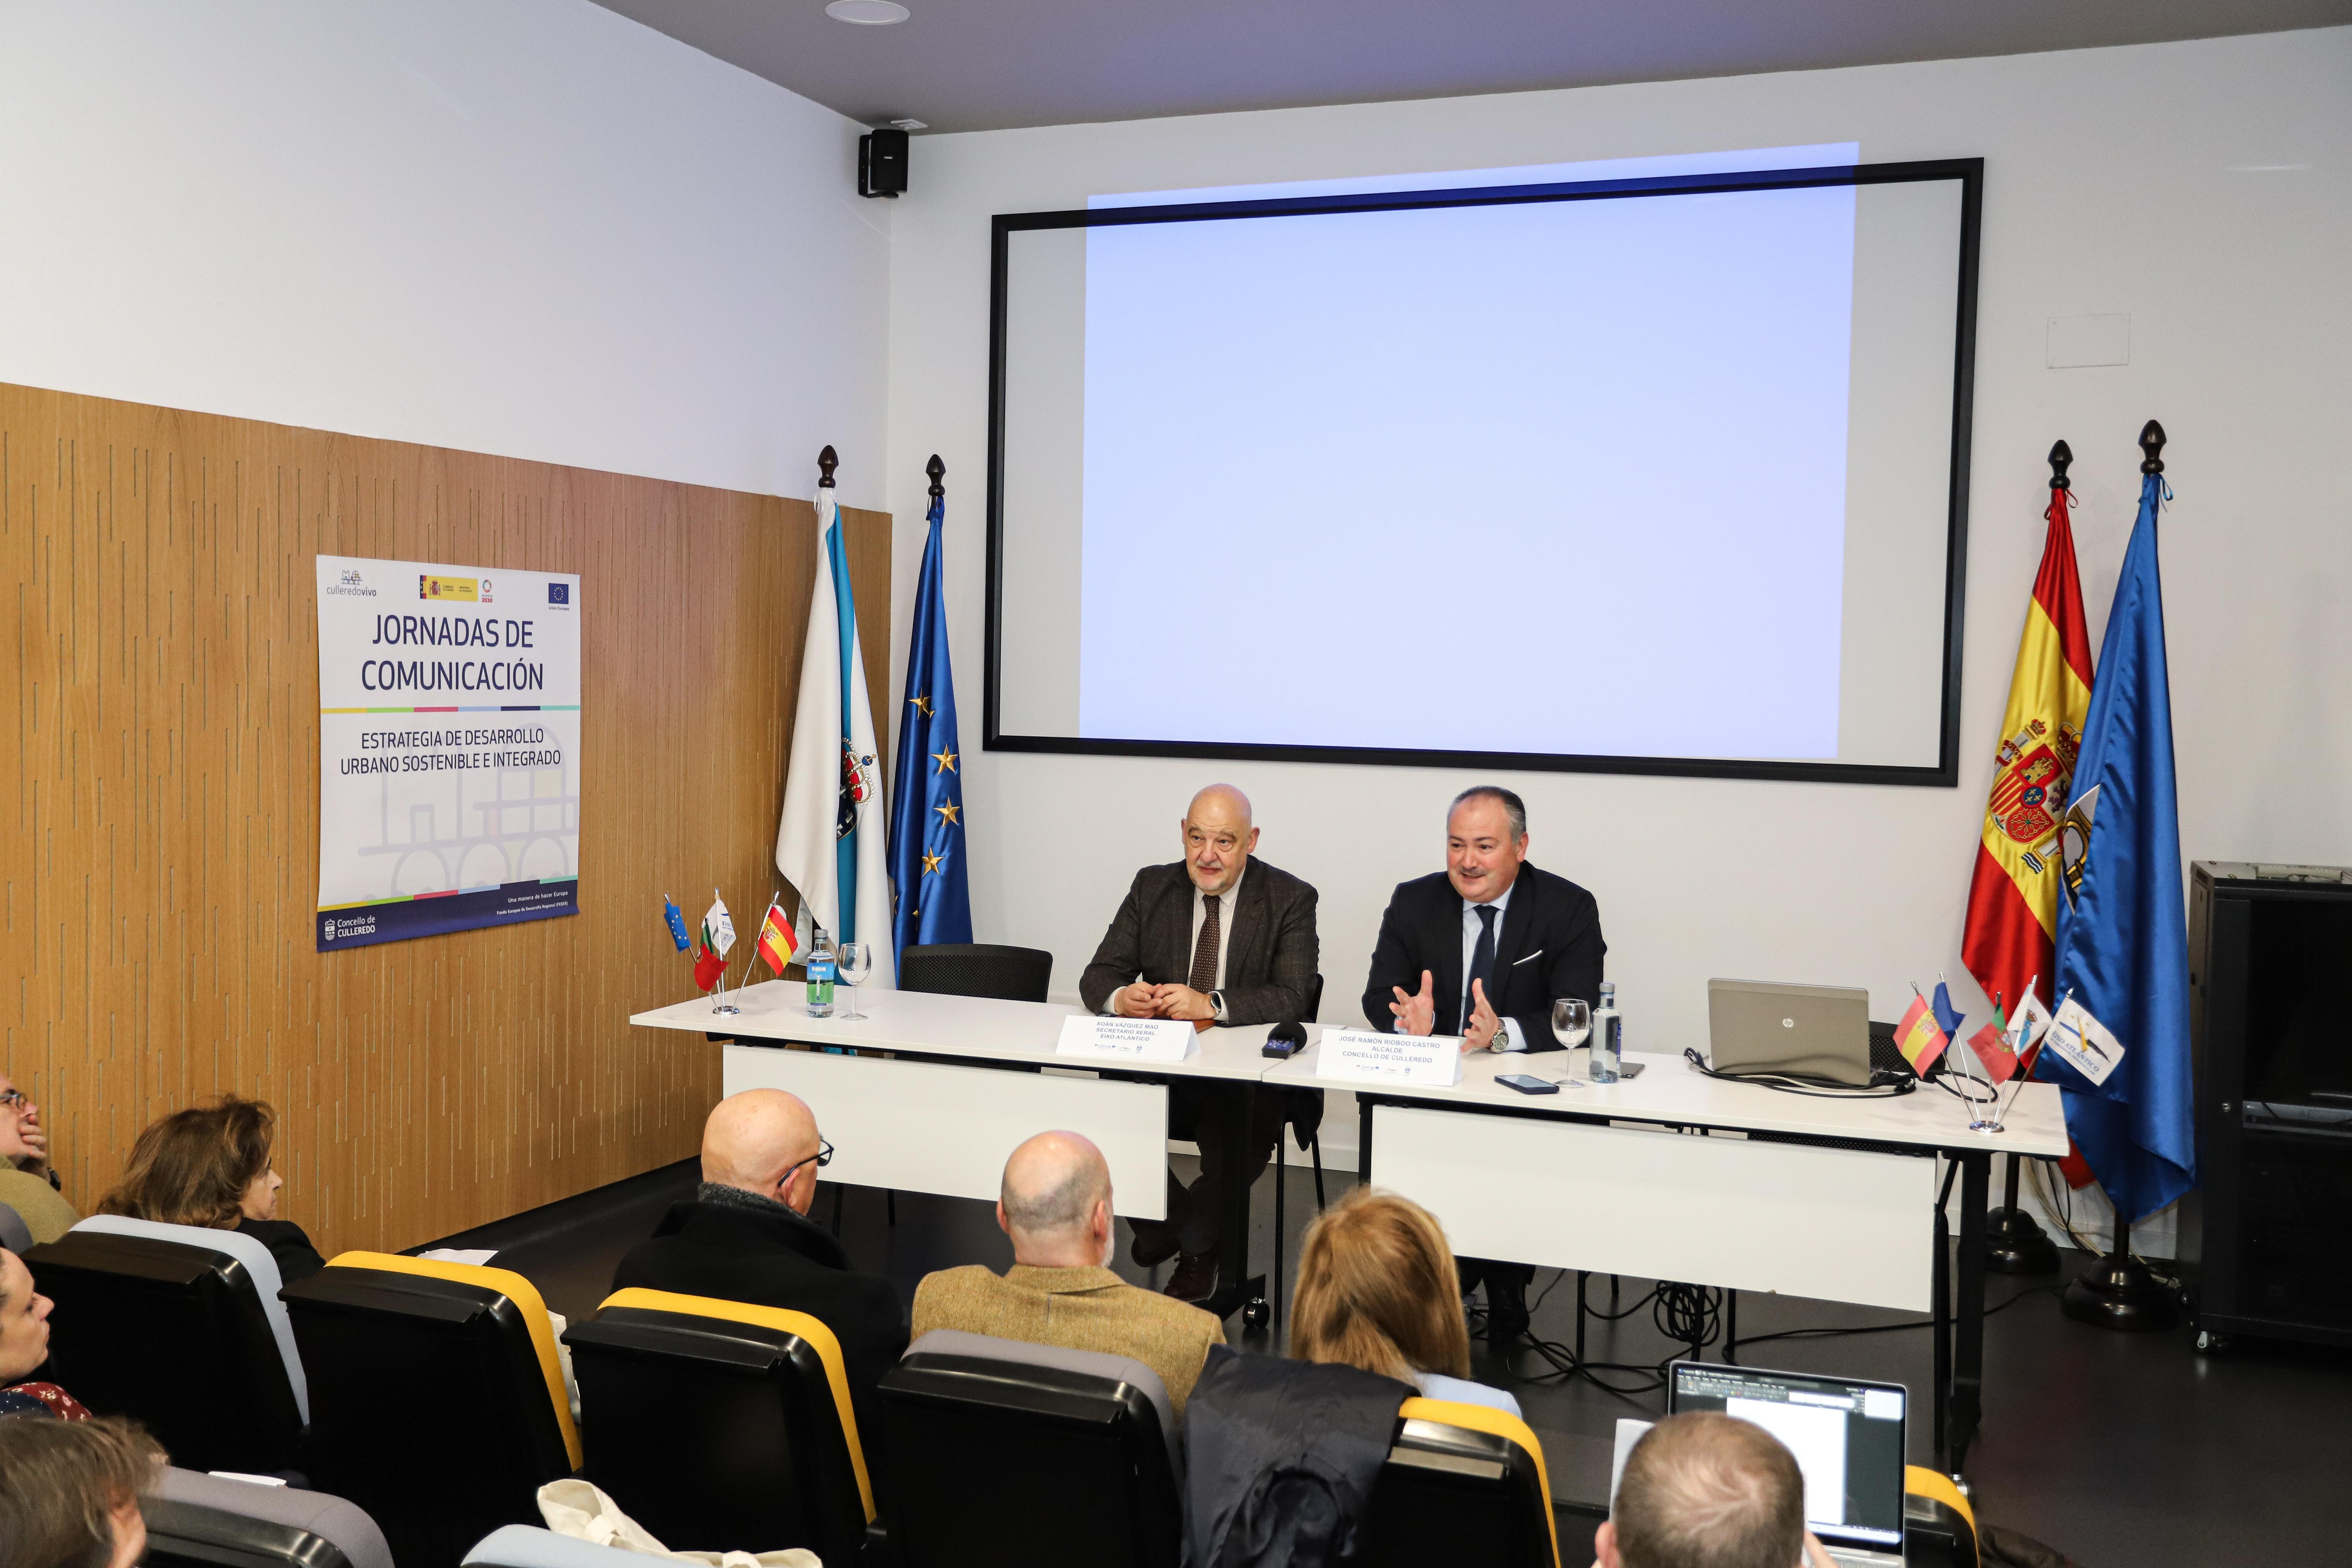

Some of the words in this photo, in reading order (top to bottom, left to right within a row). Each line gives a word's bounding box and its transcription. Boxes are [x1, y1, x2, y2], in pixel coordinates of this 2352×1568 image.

[327, 585, 377, 597] culleredovivo
[372, 615, 499, 648] JORNADAS
[506, 620, 534, 648] DE
[361, 658, 544, 691] COMUNICACIÓN
[361, 730, 443, 749] ESTRATEGIA
[446, 730, 462, 746] DE
[465, 728, 544, 745] DESARROLLO
[341, 756, 399, 775] URBANO
[402, 753, 481, 772] SOSTENIBLE
[483, 753, 490, 768] E
[493, 750, 561, 767] INTEGRADO
[337, 917, 366, 928] Concello
[367, 915, 375, 924] de
[337, 925, 375, 938] CULLEREDO
